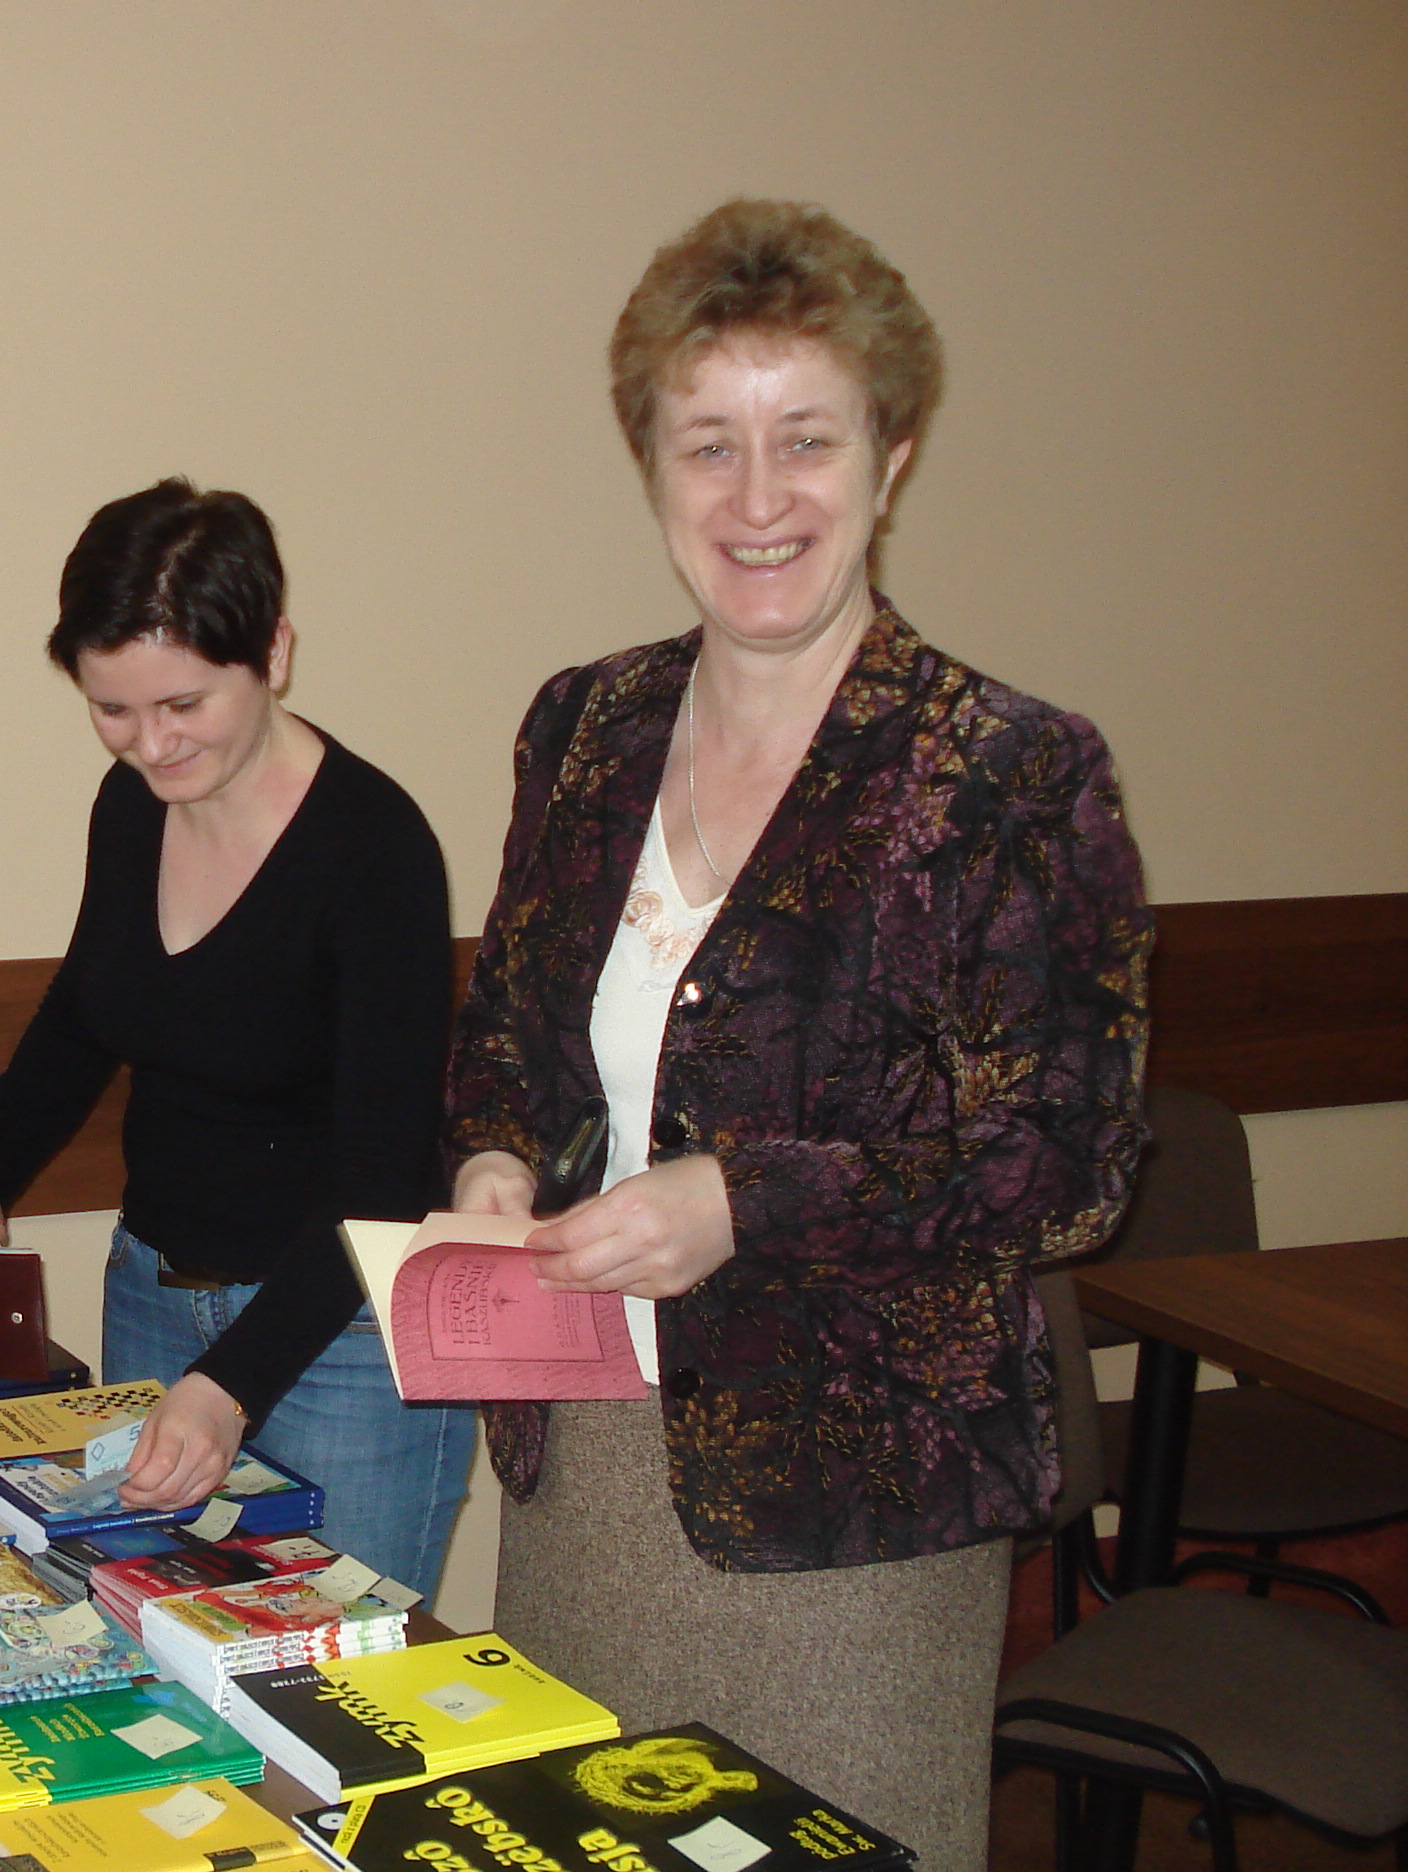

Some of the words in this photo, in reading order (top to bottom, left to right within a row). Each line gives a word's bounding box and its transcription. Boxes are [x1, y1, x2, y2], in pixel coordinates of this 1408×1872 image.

[461, 1647, 512, 1668] 6
[313, 1680, 426, 1750] zymk
[576, 1828, 661, 1872] sja
